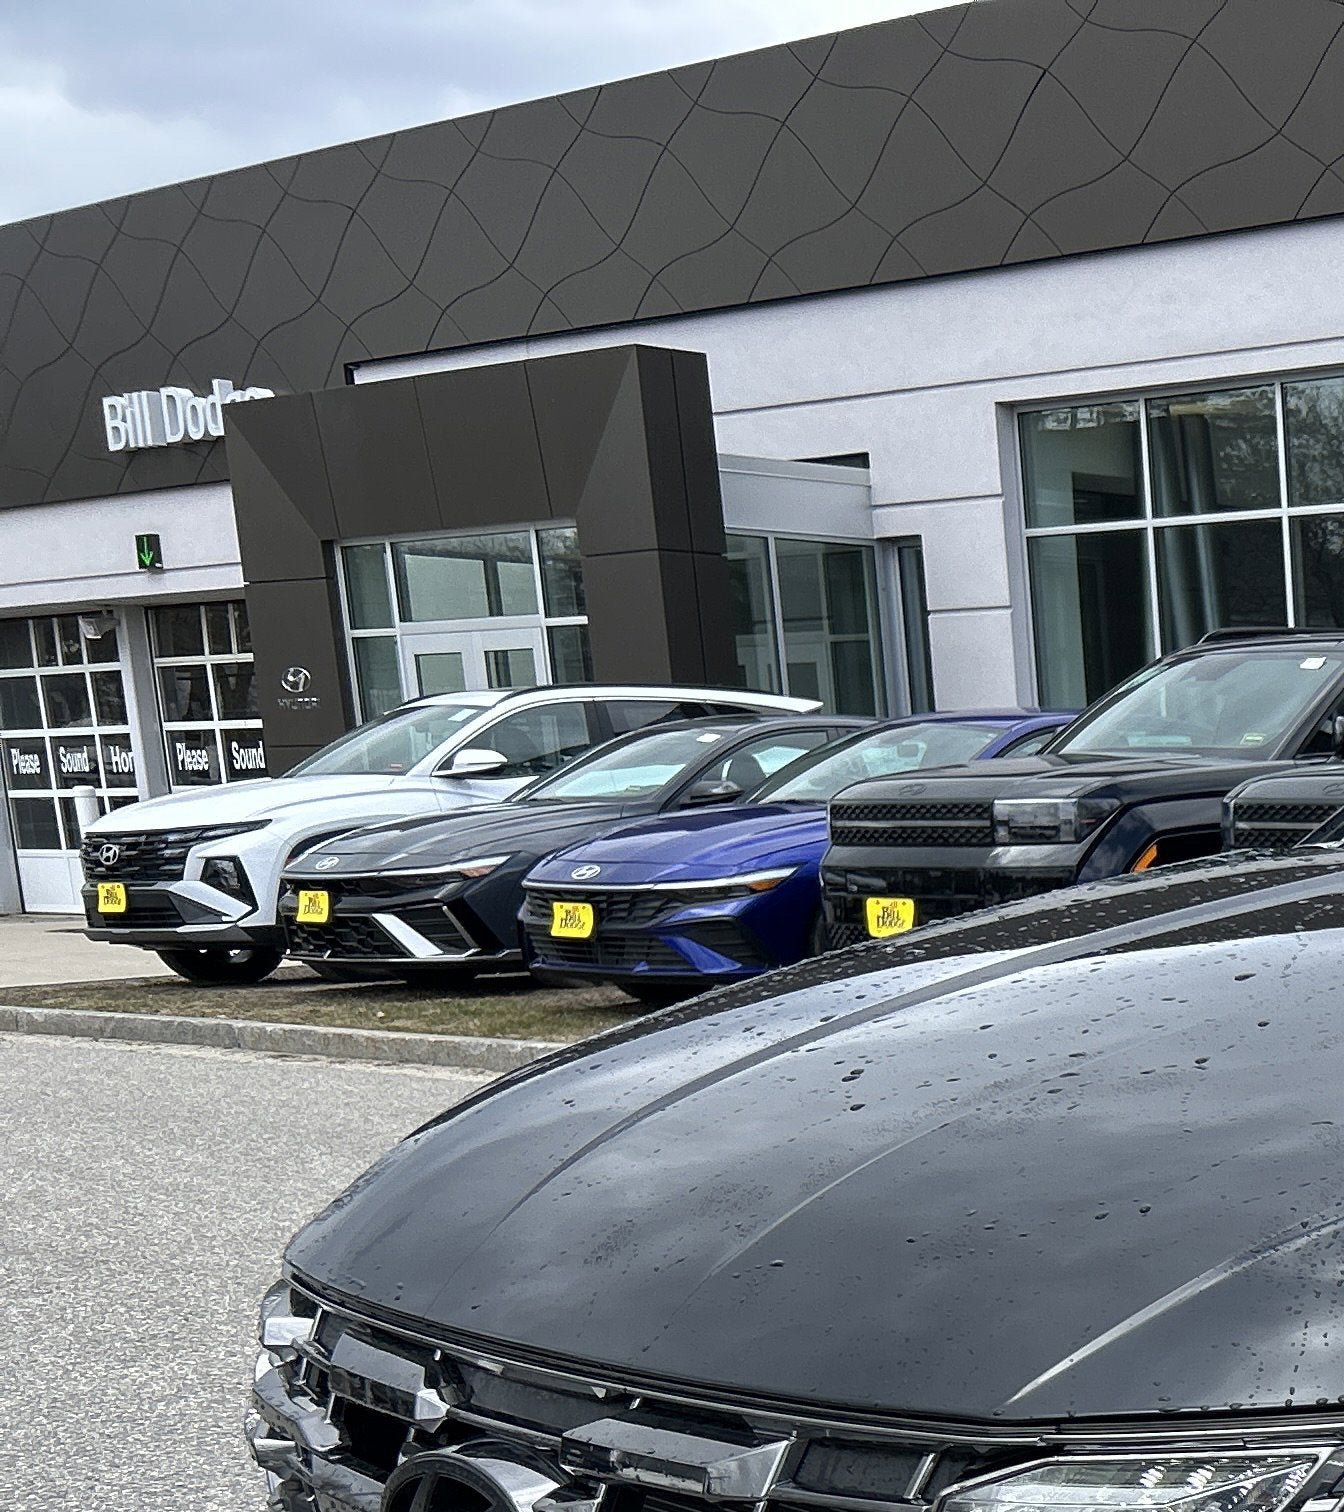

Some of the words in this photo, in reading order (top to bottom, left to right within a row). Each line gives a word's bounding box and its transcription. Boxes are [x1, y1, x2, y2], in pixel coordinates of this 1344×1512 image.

[102, 391, 161, 451] Bill
[160, 379, 275, 443] Dod
[10, 748, 40, 774] Please
[60, 746, 89, 773] Sound
[176, 743, 209, 770] Please
[232, 740, 266, 770] Sound
